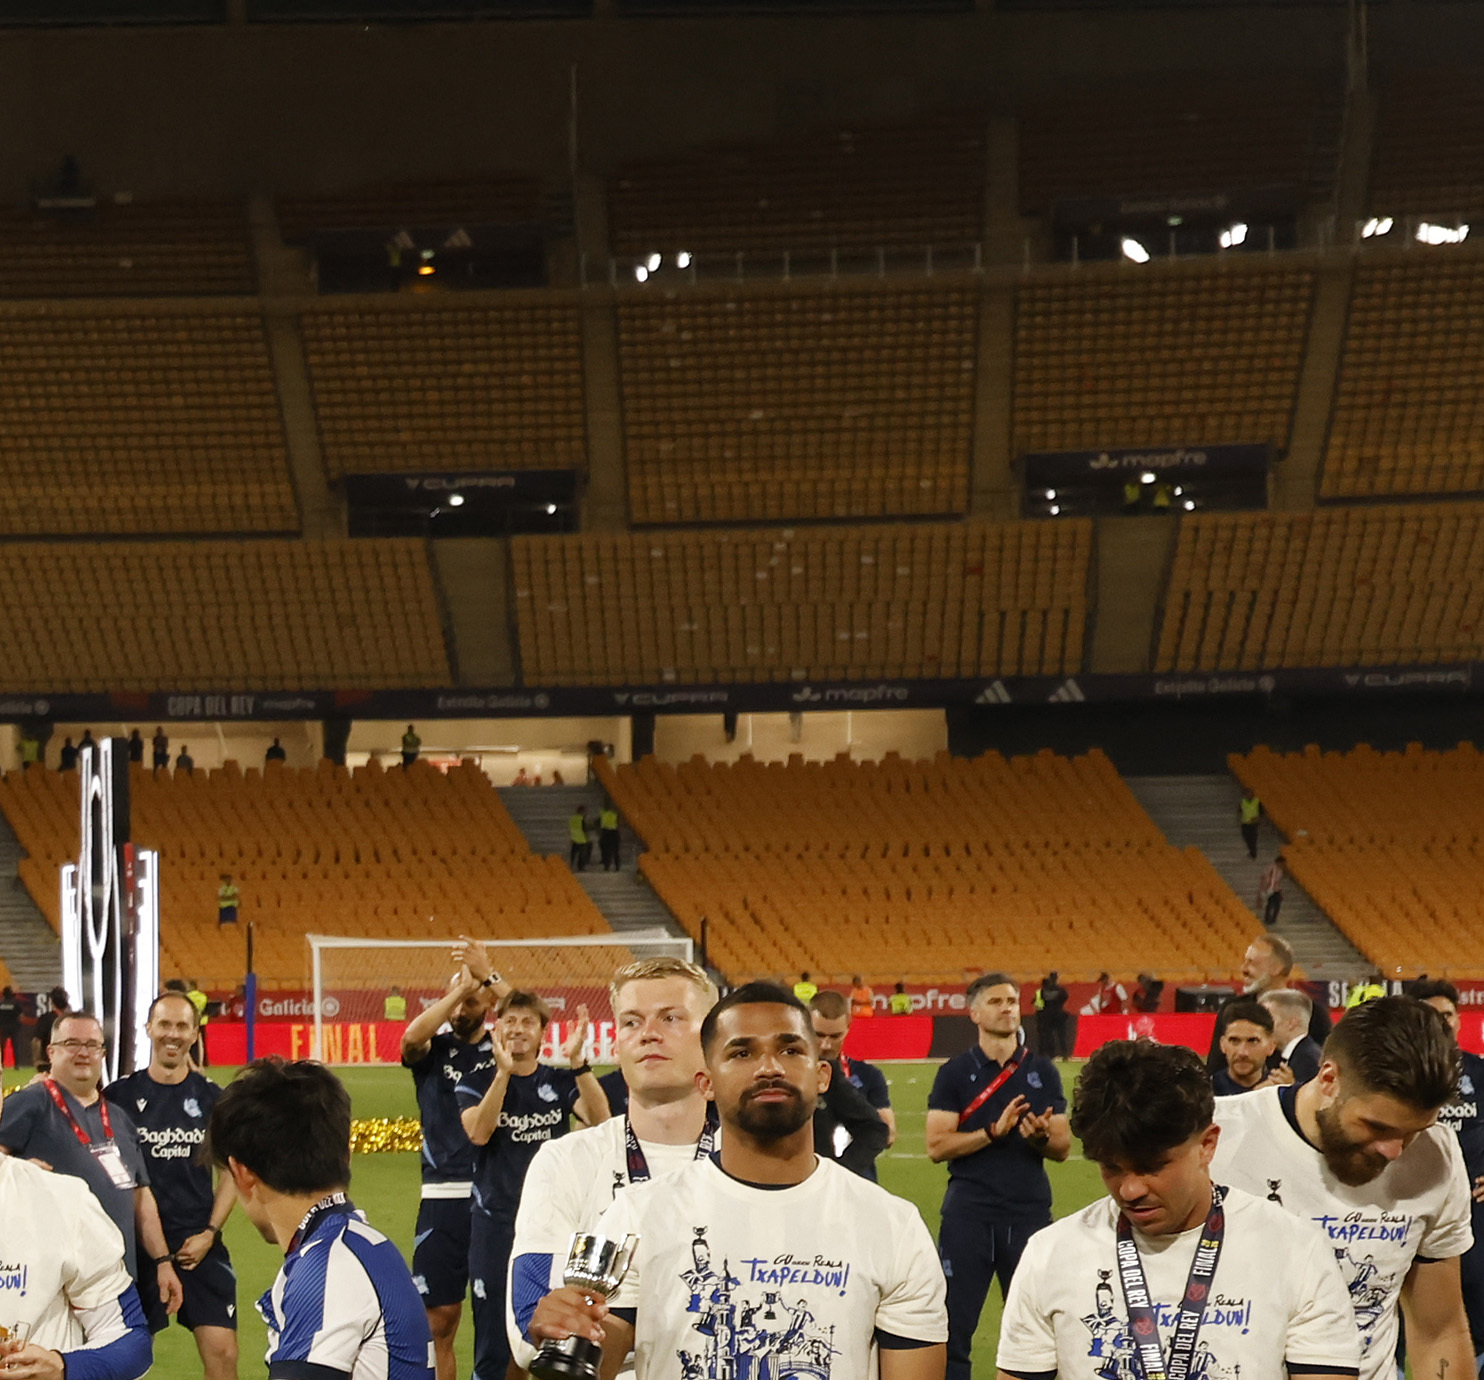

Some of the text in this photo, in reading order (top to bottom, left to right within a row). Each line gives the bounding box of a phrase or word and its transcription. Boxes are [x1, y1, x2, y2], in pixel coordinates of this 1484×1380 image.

[825, 685, 909, 704] mapfre
[496, 1108, 563, 1132] Baghdadi
[150, 1145, 191, 1161] Capital
[1117, 1240, 1150, 1308] COPA DEL REY
[1192, 1247, 1218, 1277] FINAL
[1139, 1343, 1165, 1374] FINAL
[1168, 1309, 1201, 1380] COPA DEL REY
